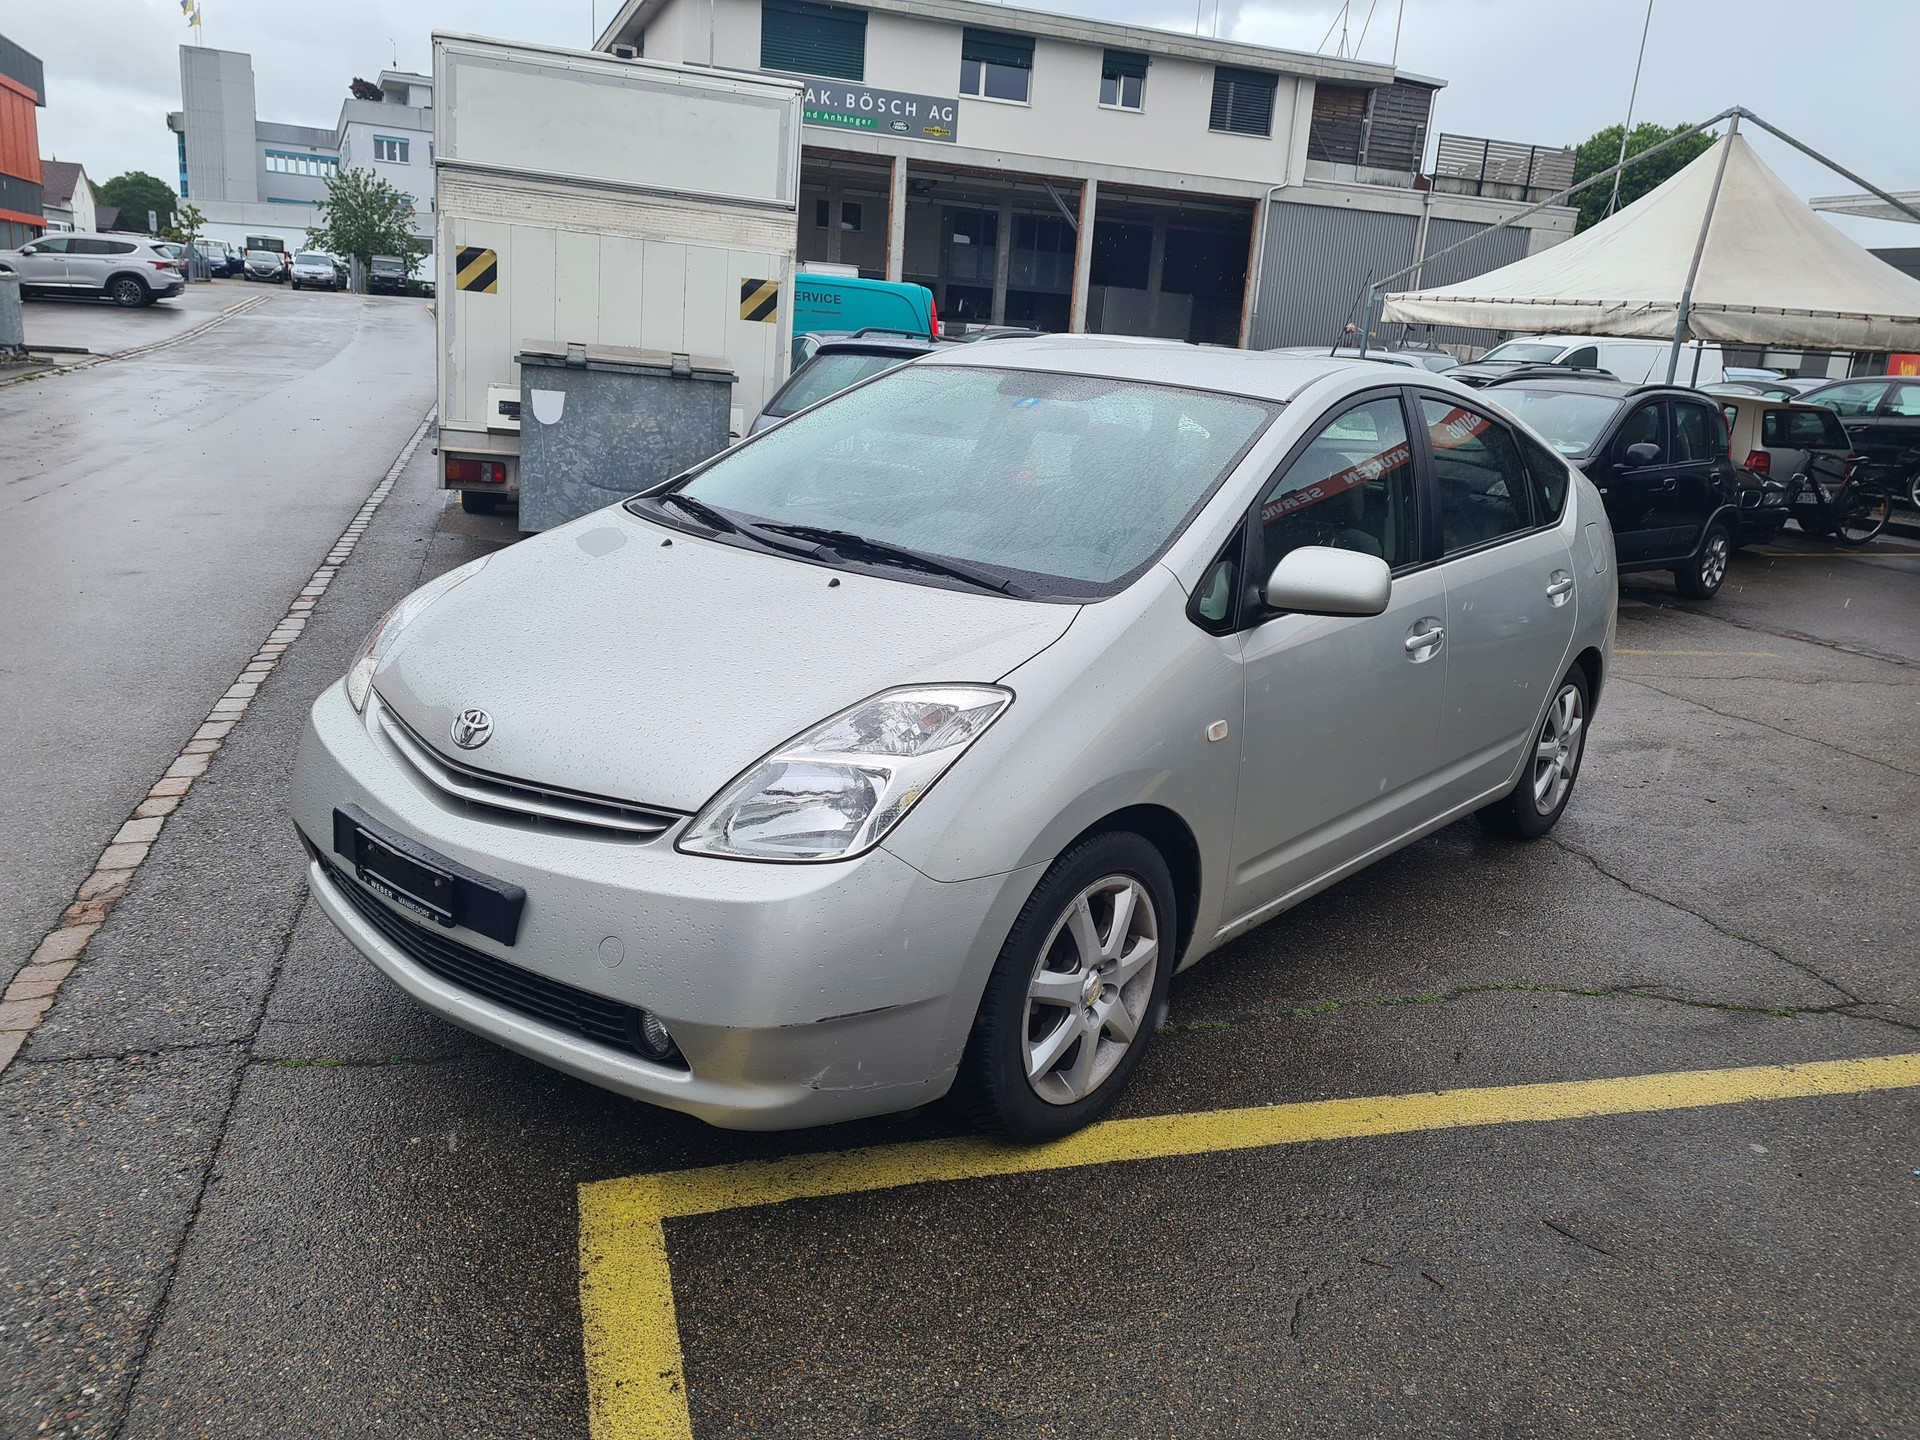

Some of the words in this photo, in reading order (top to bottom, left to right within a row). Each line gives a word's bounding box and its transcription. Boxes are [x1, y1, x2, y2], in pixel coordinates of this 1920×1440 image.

[846, 92, 916, 117] BÖSCH
[928, 105, 953, 121] AG
[823, 113, 872, 126] Anhänger
[370, 880, 393, 898] WEBER
